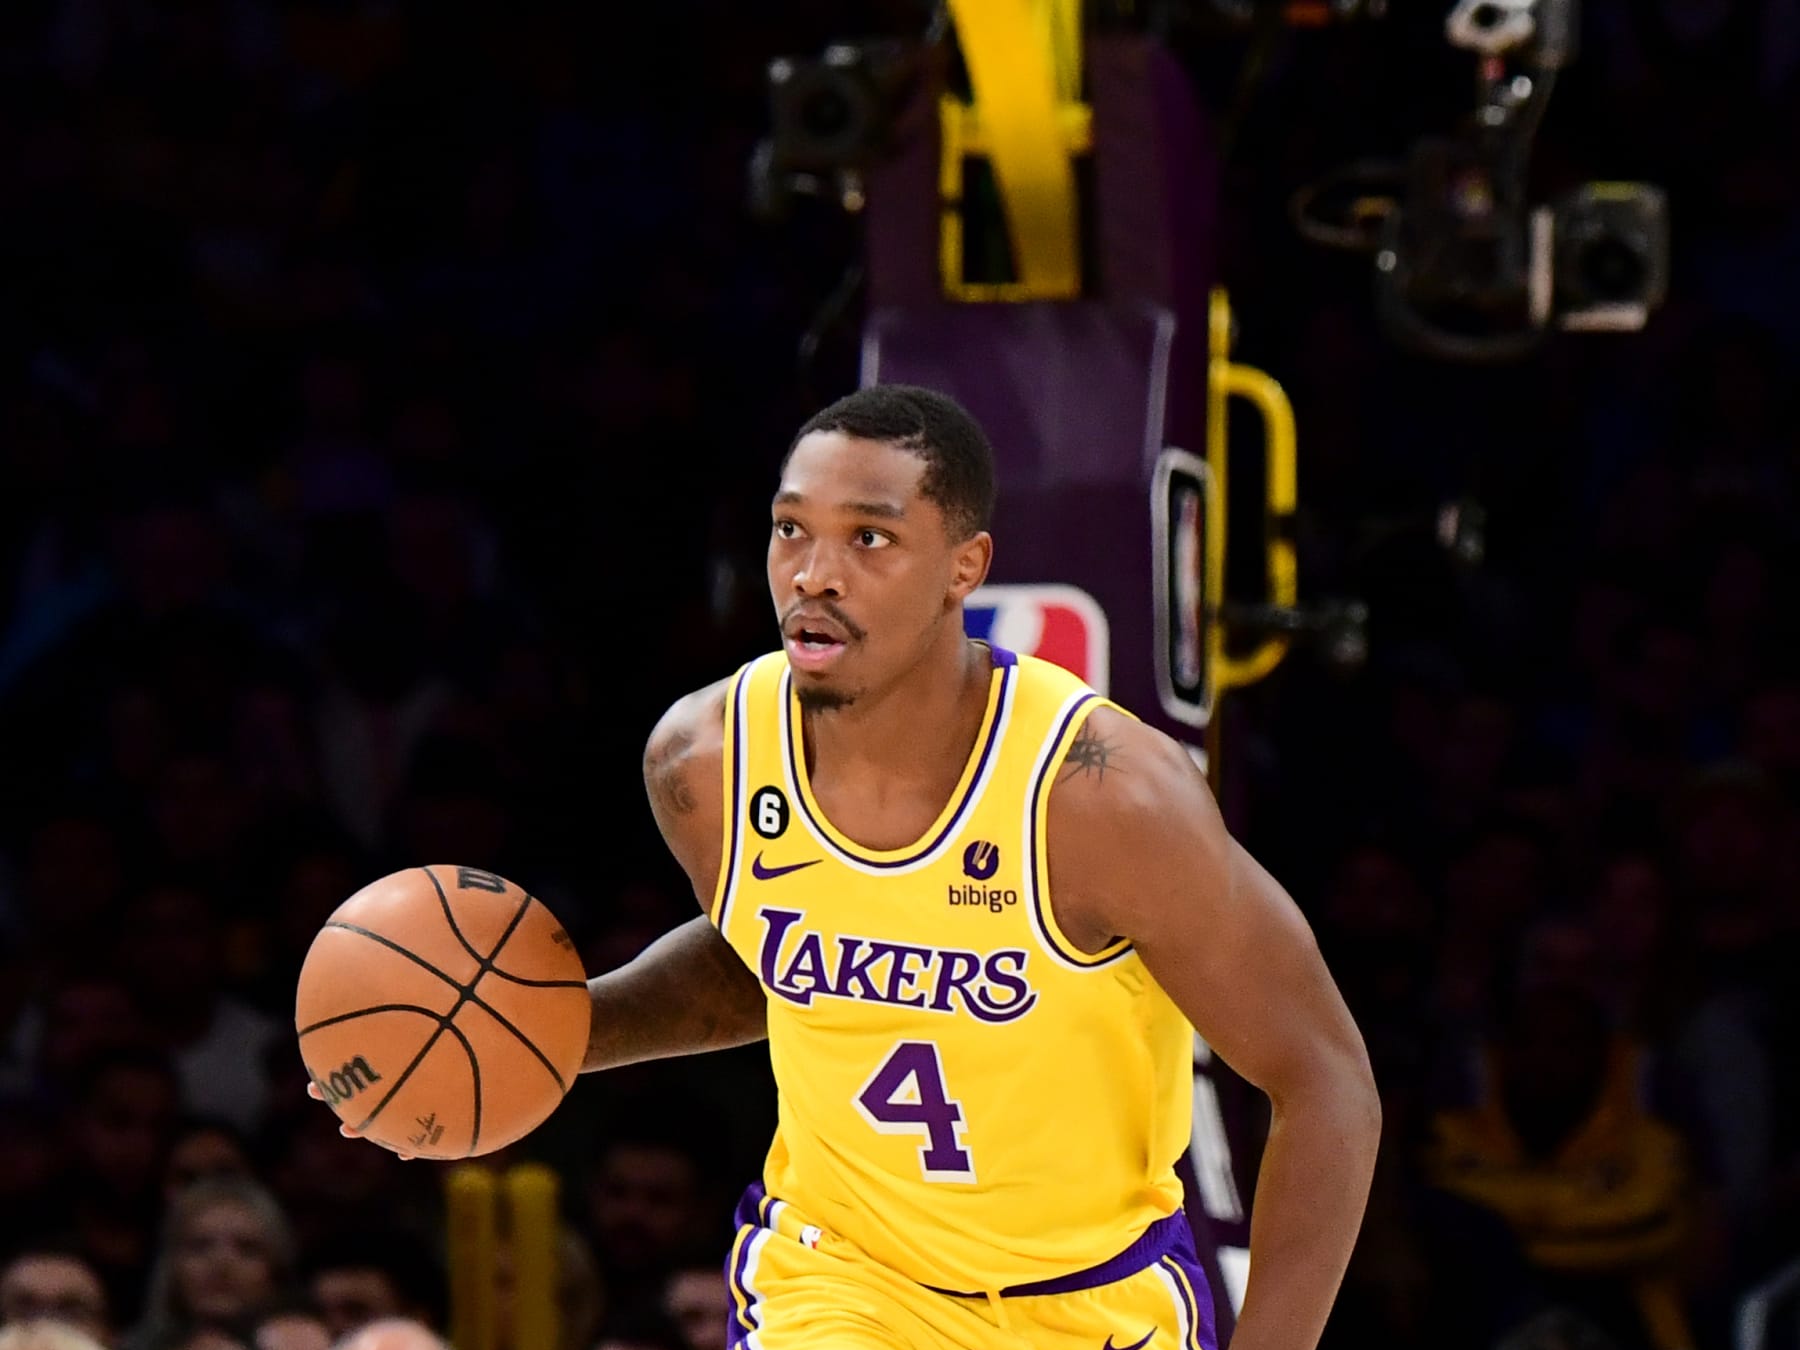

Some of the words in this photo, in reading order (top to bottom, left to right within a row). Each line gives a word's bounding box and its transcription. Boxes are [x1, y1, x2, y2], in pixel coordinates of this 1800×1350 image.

[758, 791, 782, 834] 6
[948, 884, 1017, 913] bibigo
[758, 906, 1038, 1024] LAKERS
[850, 1039, 978, 1185] 4
